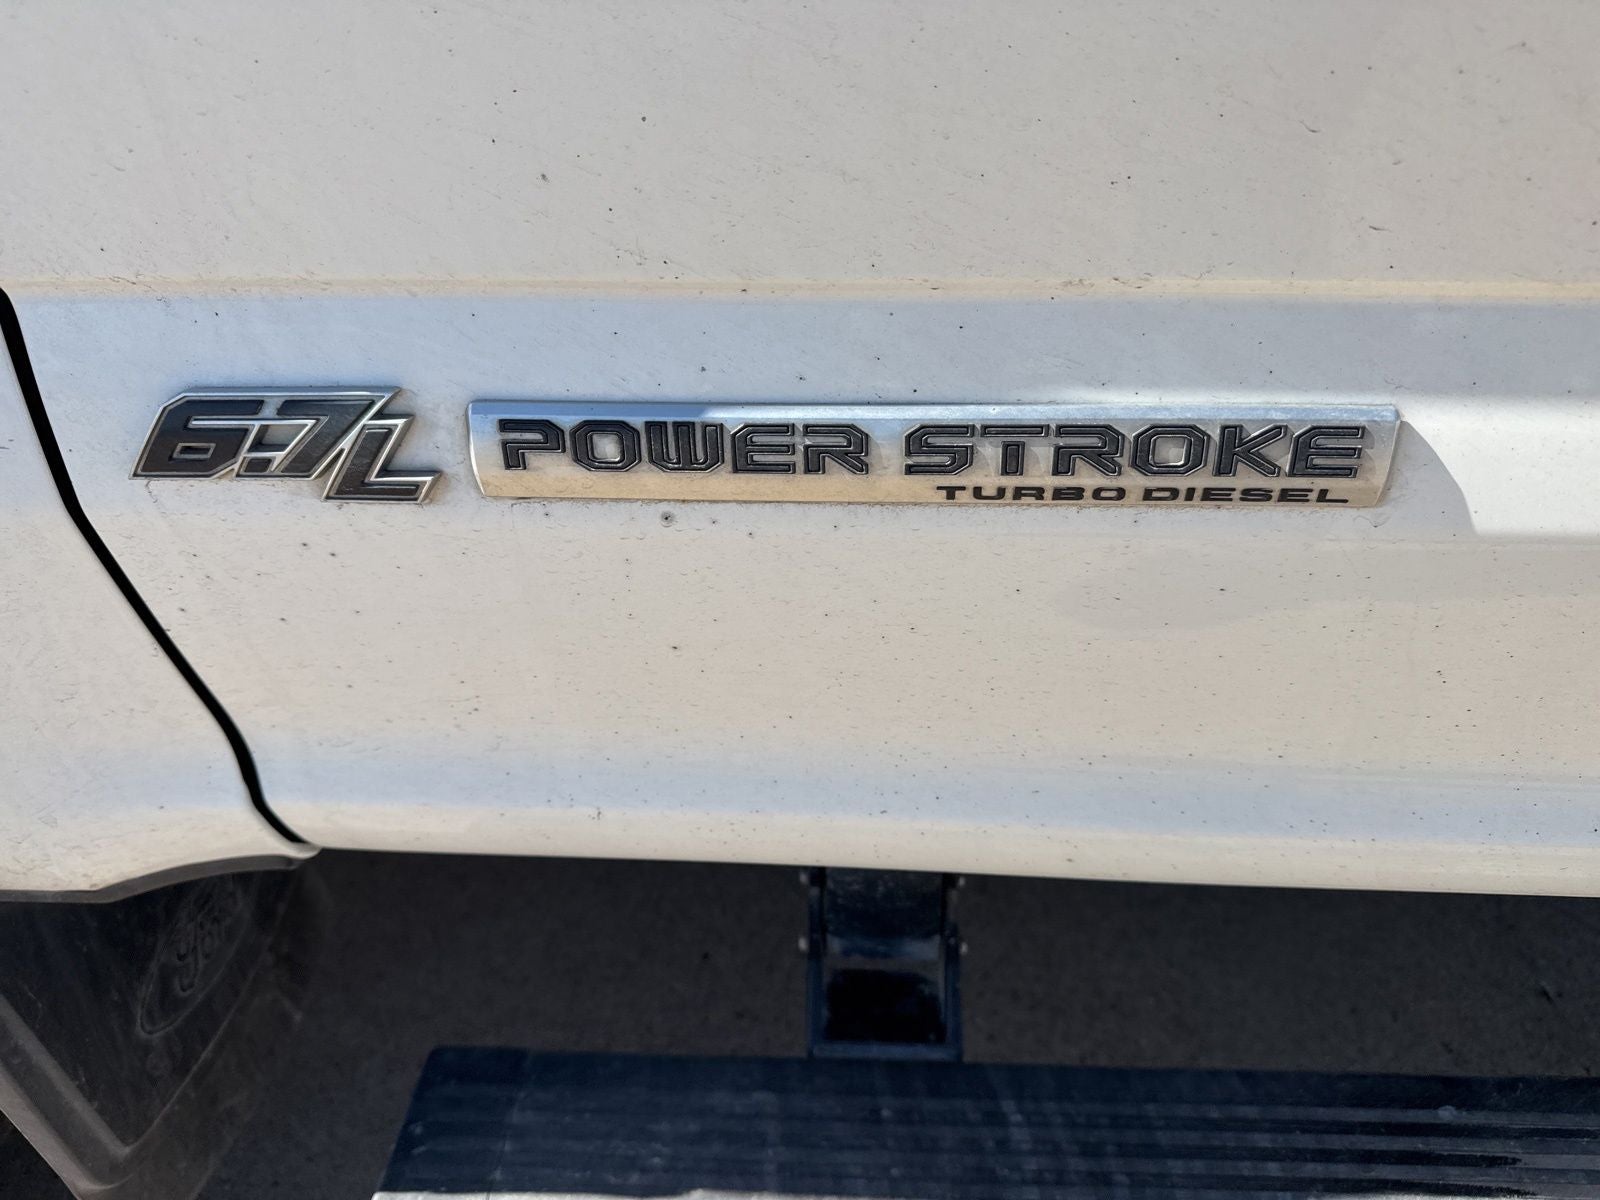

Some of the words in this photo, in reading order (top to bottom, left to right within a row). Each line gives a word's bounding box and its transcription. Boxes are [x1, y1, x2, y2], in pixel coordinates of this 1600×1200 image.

[498, 418, 869, 475] POWER
[904, 423, 1366, 478] STROKE
[936, 486, 1127, 503] TURBO
[1142, 487, 1349, 505] DIESEL
